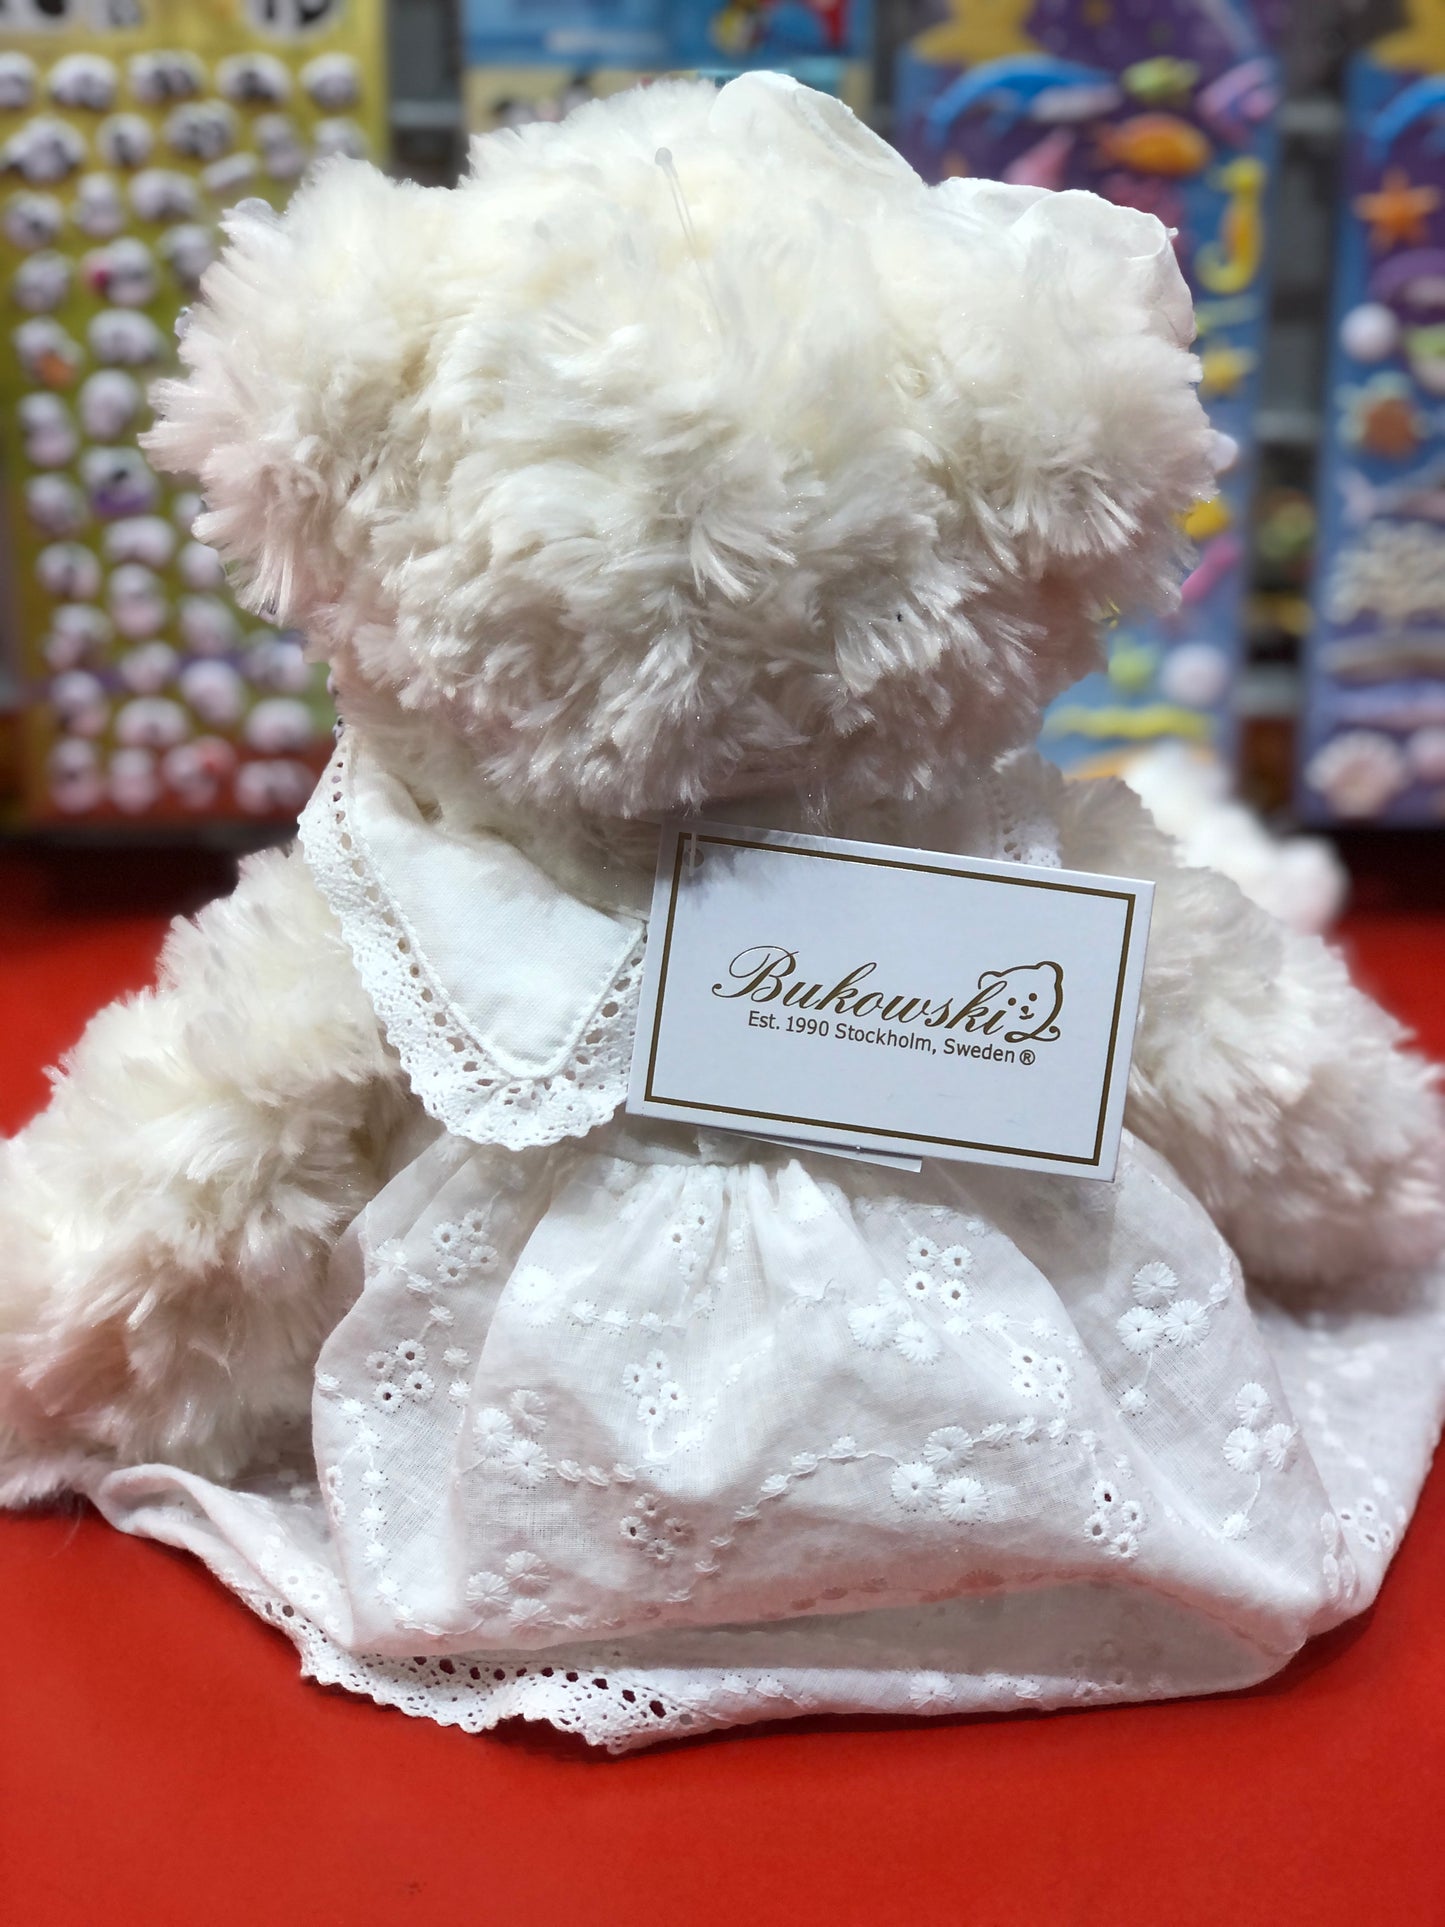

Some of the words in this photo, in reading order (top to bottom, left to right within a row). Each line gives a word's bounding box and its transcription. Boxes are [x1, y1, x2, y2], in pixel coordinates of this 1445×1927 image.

[711, 945, 1008, 1036] Bukowski
[748, 1010, 780, 1030] Est.
[785, 1015, 830, 1037] 1990
[834, 1022, 937, 1055] Stockholm,
[943, 1037, 1015, 1064] Sweden
